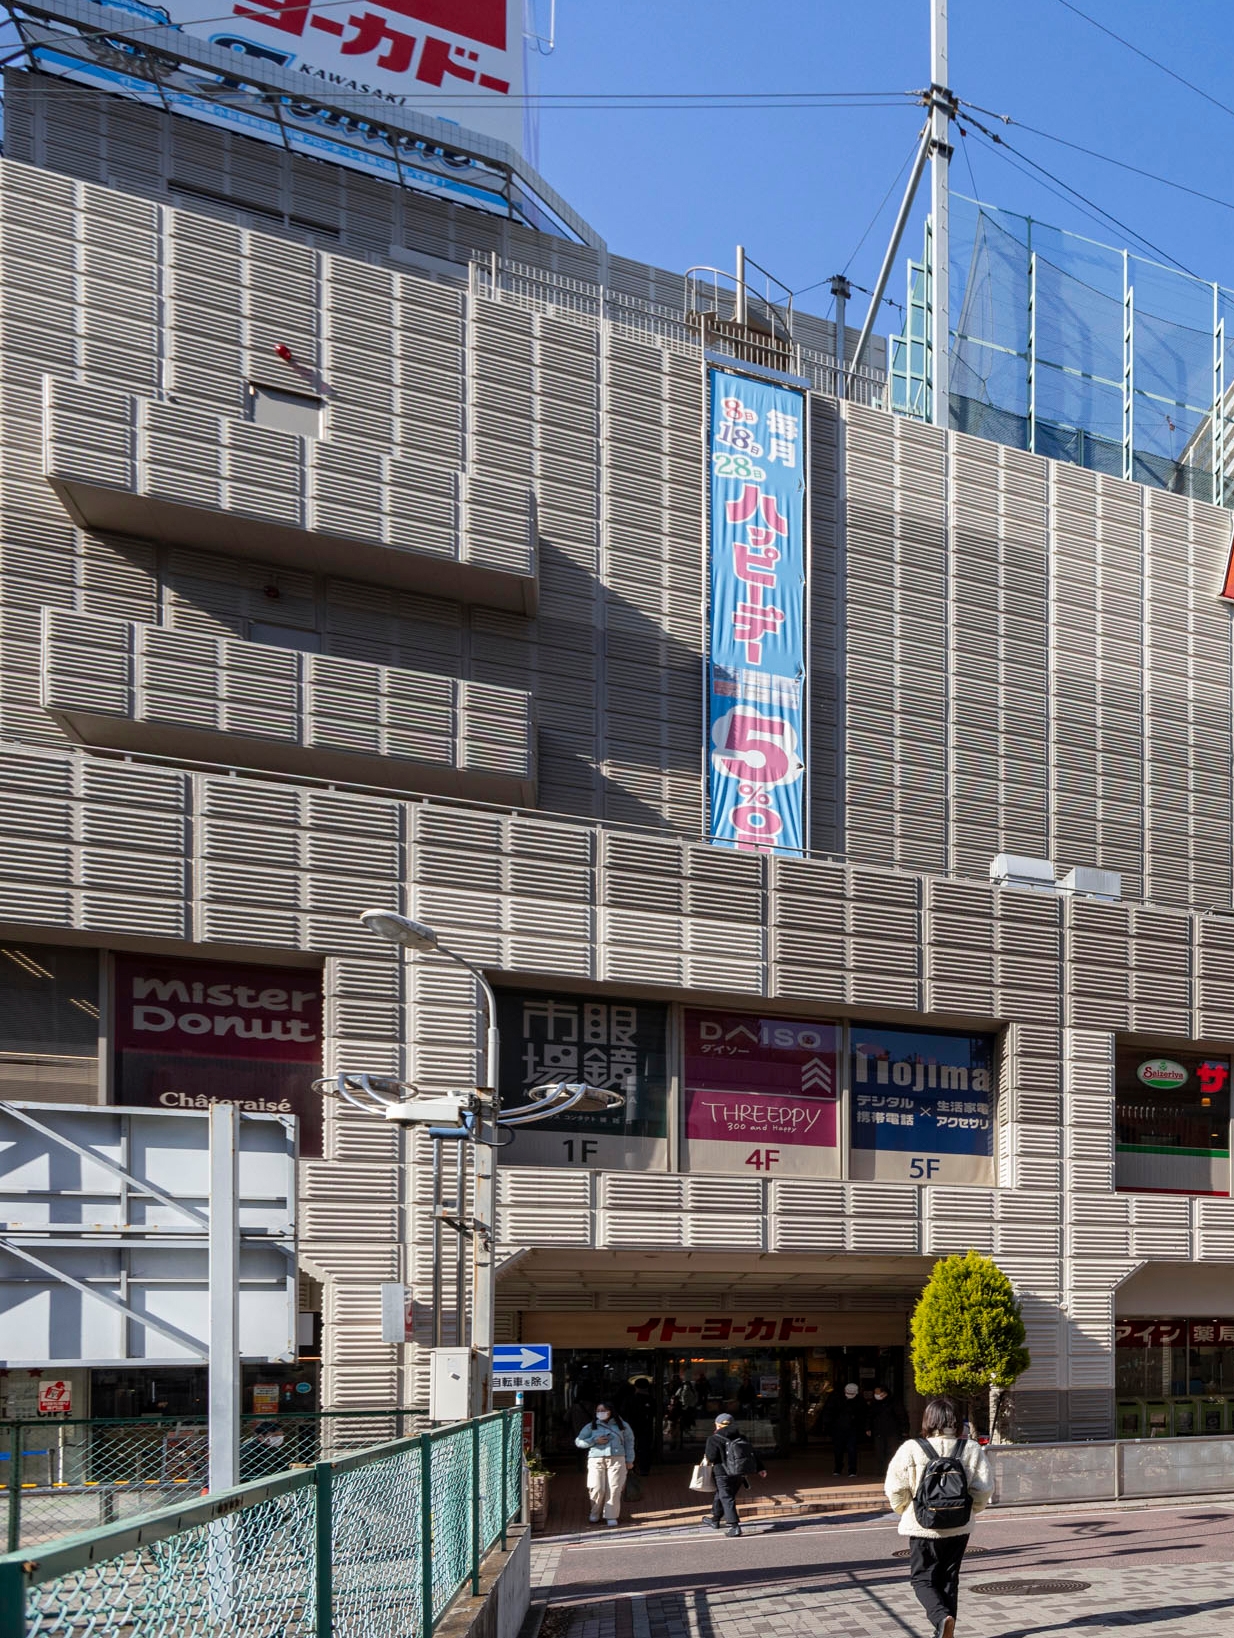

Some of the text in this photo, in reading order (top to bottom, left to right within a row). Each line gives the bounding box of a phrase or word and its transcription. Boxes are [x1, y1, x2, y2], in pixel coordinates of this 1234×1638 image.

[298, 63, 406, 107] KAWASAKI
[722, 398, 755, 421] 8日
[718, 424, 760, 455] 18日
[767, 409, 798, 468] 毎月
[714, 454, 763, 480] 28日
[727, 484, 788, 664] ハッピーデー
[132, 1005, 317, 1043] Donut
[700, 1021, 821, 1048] DAISO
[700, 1044, 750, 1055] ダイソー
[855, 1043, 990, 1092] Nojima
[1143, 1066, 1185, 1080] Saizeriya
[701, 1101, 821, 1133] THREEPPY
[856, 1095, 914, 1109] デジタル
[936, 1100, 989, 1115] 生活家電
[727, 1122, 797, 1133] 300 and Happy
[856, 1111, 989, 1130] 携帯電話 アクセサリ
[562, 1139, 598, 1163] 1F
[745, 1149, 780, 1171] 4F
[909, 1158, 940, 1179] 5F
[626, 1316, 818, 1341] イトーヨーカドー
[492, 1376, 549, 1388] 自転車を除く
